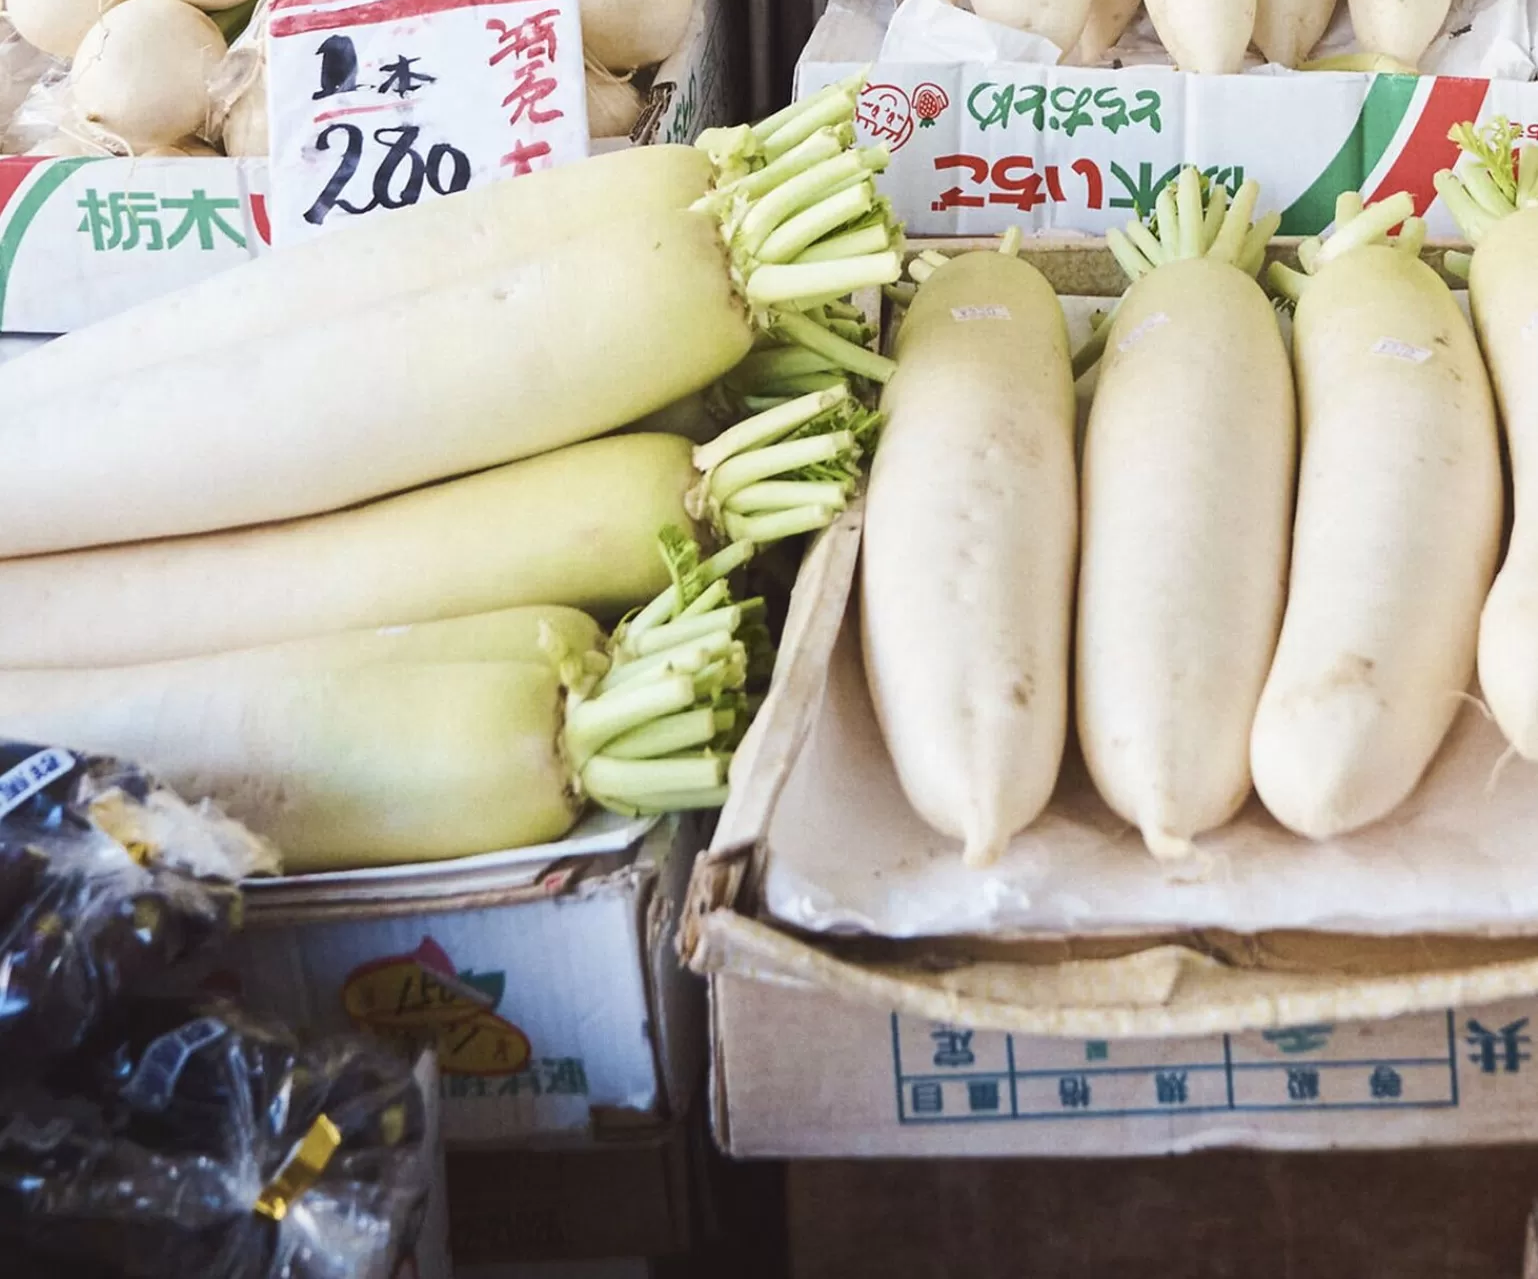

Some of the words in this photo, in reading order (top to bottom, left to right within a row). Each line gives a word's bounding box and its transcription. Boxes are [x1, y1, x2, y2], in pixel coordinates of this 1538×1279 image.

[312, 34, 437, 102] 1本
[966, 81, 1162, 137] とちおとめ
[302, 122, 472, 226] 280
[1466, 1017, 1532, 1074] 共
